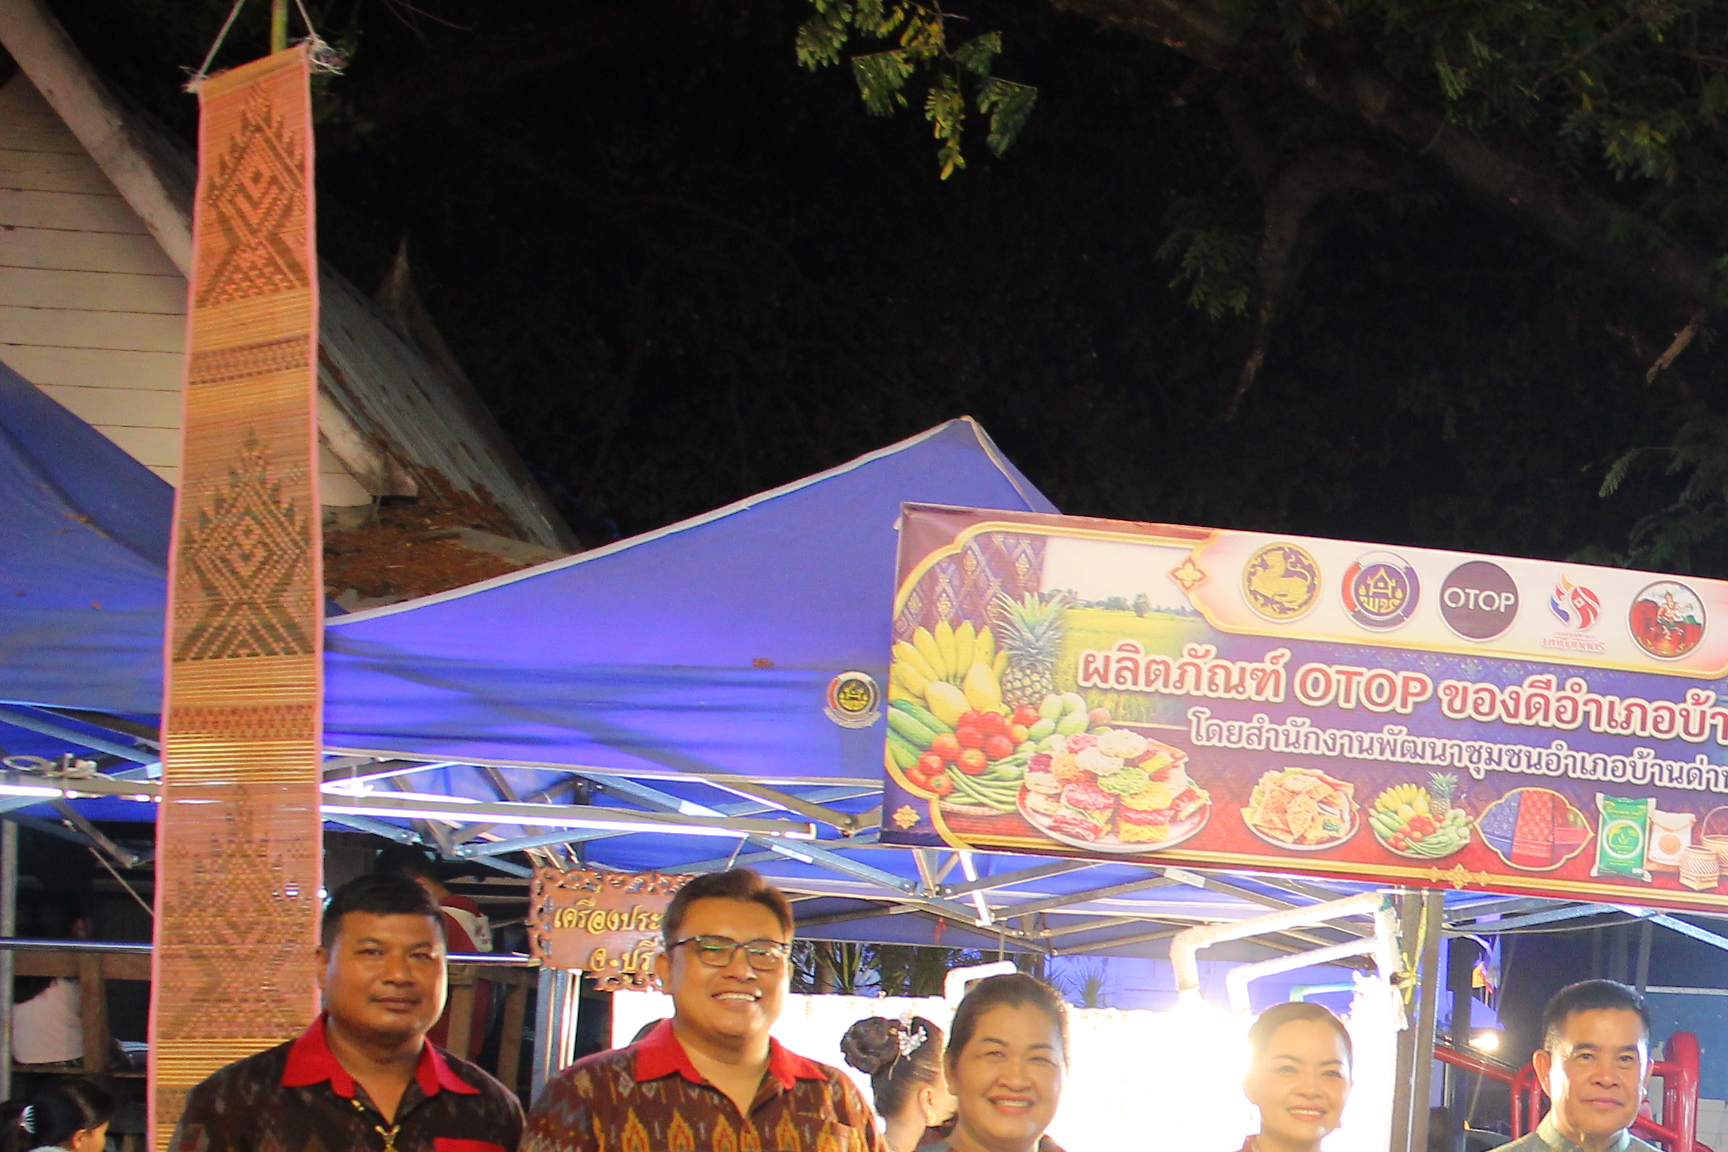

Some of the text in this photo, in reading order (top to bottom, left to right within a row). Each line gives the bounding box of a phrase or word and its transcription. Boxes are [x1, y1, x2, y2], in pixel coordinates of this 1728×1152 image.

[1443, 586, 1517, 614] OTOP
[1081, 642, 1290, 699] ผลิตภัณฑ์
[1297, 666, 1429, 709] OTOP
